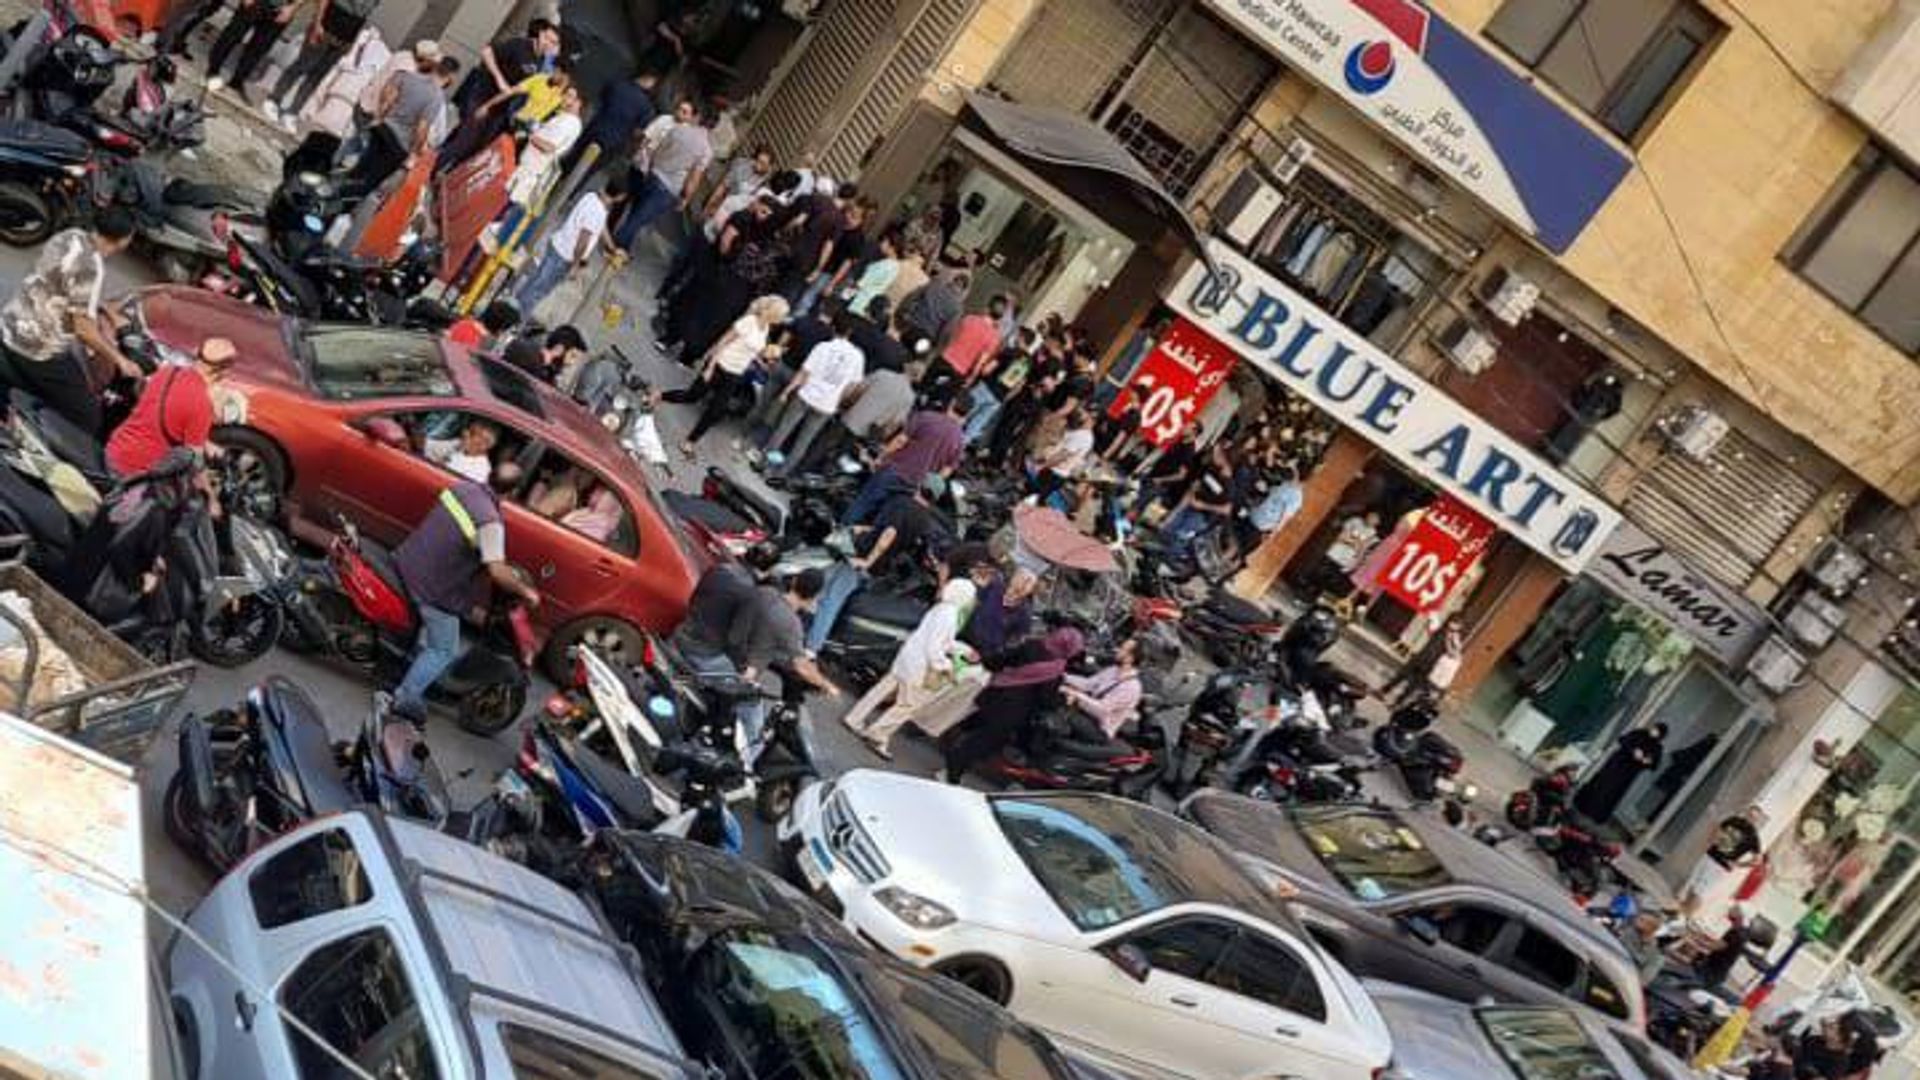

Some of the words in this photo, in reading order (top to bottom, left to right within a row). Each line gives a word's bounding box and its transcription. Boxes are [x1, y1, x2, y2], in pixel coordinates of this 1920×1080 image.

[1280, 24, 1325, 63] Center
[1136, 373, 1196, 446] 0$
[1230, 288, 1417, 436] BLUE
[1413, 422, 1566, 530] ART
[1387, 541, 1457, 607] 10$
[1602, 547, 1740, 636] Lamar
